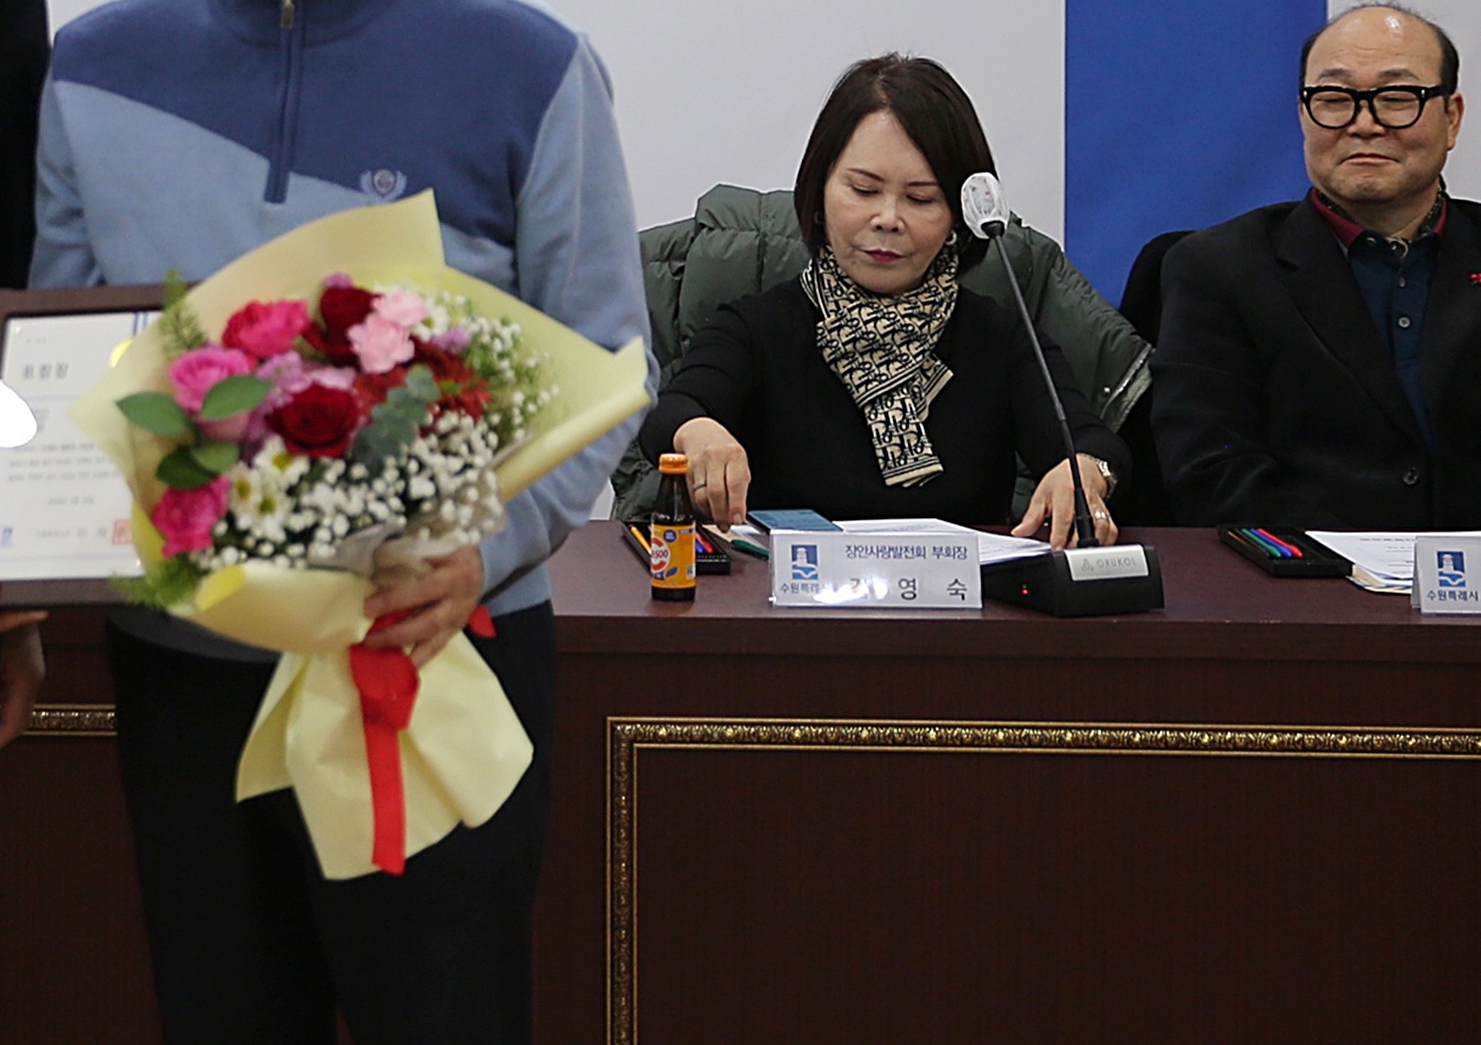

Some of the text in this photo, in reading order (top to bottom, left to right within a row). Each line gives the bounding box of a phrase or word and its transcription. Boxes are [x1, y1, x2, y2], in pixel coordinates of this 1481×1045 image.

[844, 544, 968, 560] 장안사랑발전회 부회장
[780, 582, 829, 594] 수원특례
[1426, 589, 1479, 602] 수원특례시
